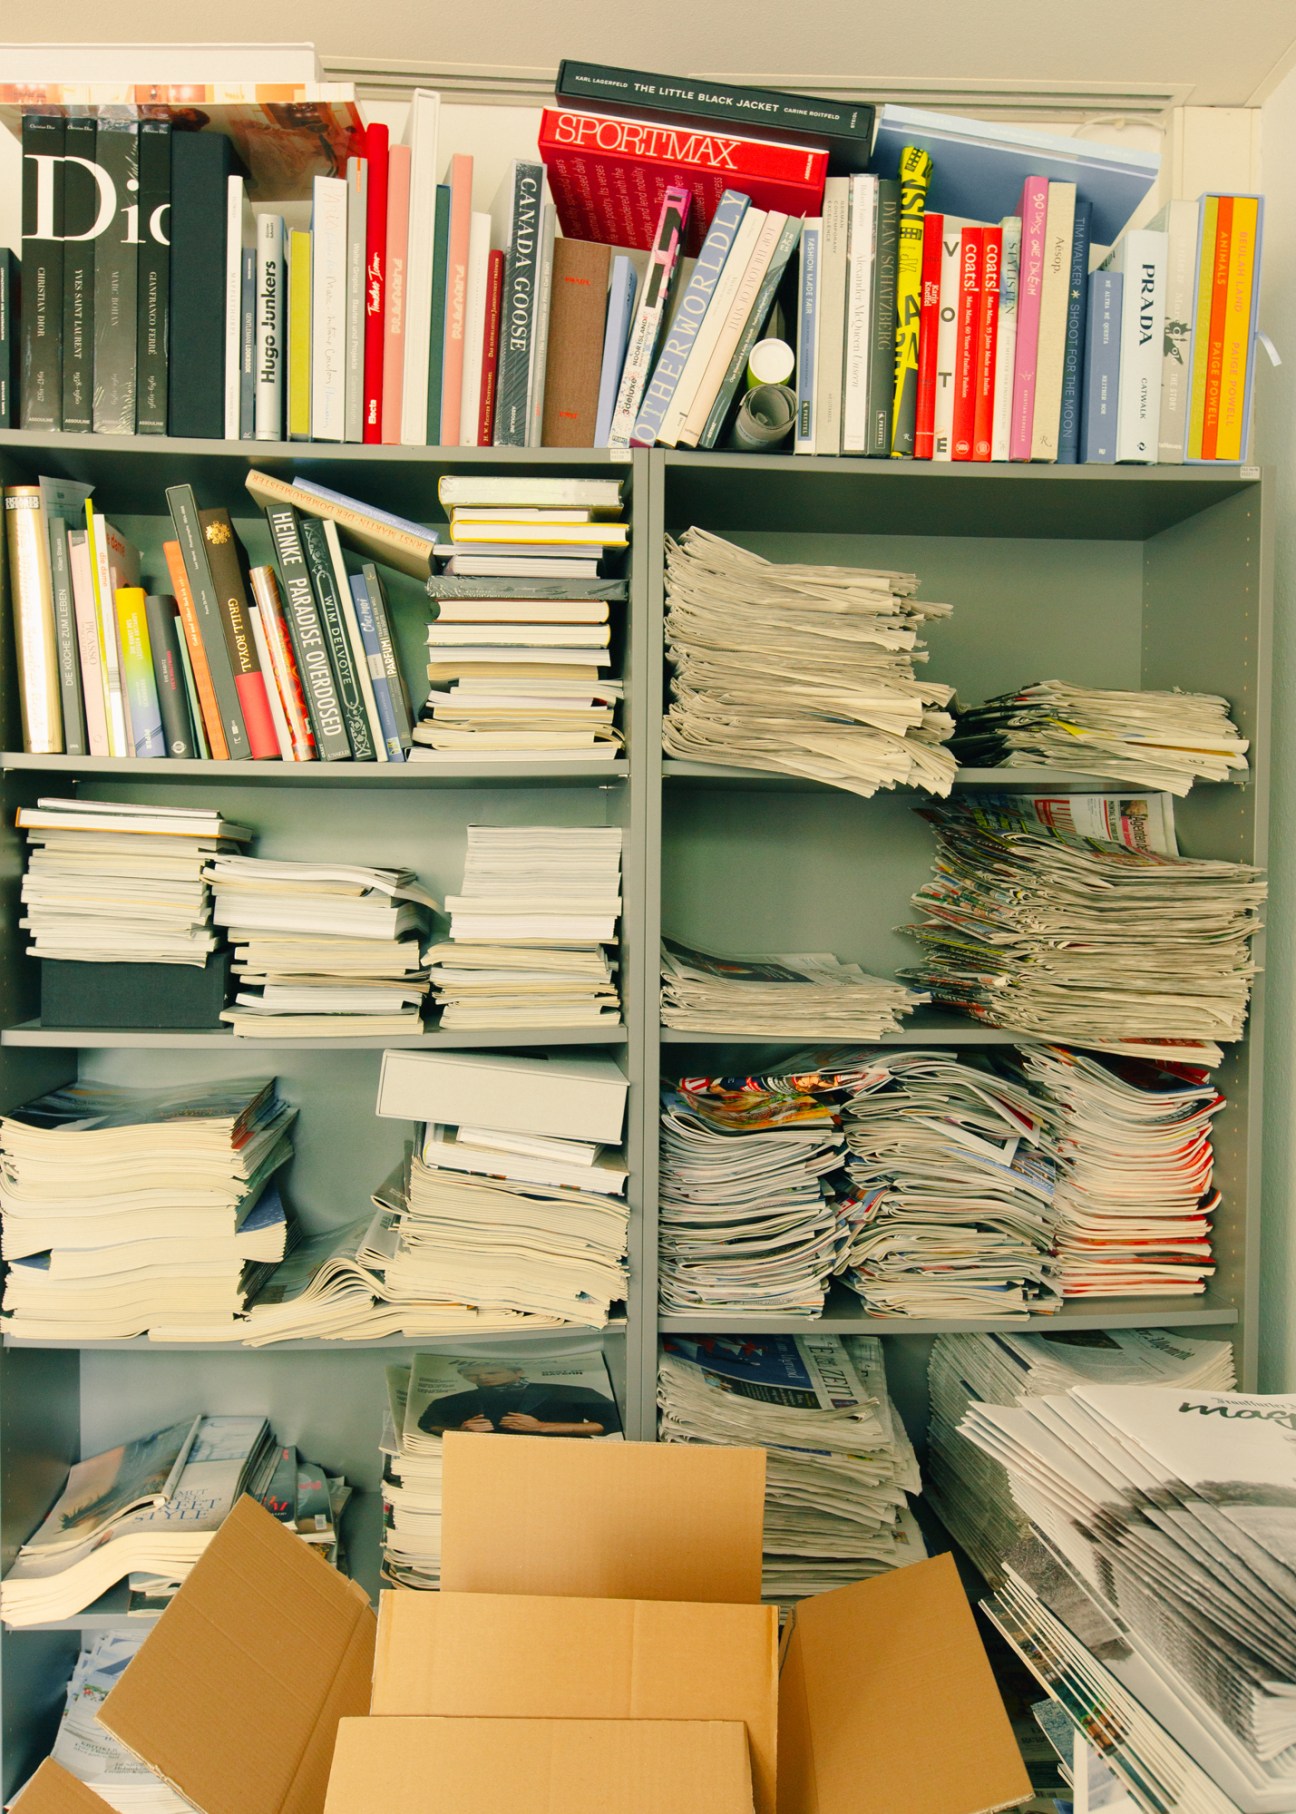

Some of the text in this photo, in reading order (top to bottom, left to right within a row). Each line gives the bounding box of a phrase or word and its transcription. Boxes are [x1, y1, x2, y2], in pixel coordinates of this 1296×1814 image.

[575, 75, 629, 89] KARL LAGERFELD
[634, 83, 781, 113] THE LITTLE BLACK JACKET
[784, 107, 840, 121] CARINE ROITFELD
[555, 113, 742, 169] SPORTMAX
[555, 159, 569, 177] years
[573, 157, 587, 174] daily
[594, 165, 606, 186] verses
[613, 168, 625, 179] the
[578, 175, 591, 198] infused
[583, 199, 593, 211] has
[616, 179, 627, 194] with
[632, 167, 651, 220] and lend nobility
[654, 176, 667, 204] They are
[693, 182, 708, 220] clothes that
[713, 176, 723, 198] excess
[1031, 193, 1046, 209] 90
[606, 219, 616, 233] with
[617, 195, 636, 236] embroidered
[1030, 211, 1044, 235] DAYS
[508, 178, 537, 351] CANADA GOOSE
[805, 237, 815, 273] FASHION
[1030, 239, 1041, 257] ONE
[1051, 236, 1066, 274] Aesop.
[1216, 230, 1229, 286] ANIMALS
[111, 271, 120, 295] MARC
[804, 273, 815, 297] MADE
[963, 243, 980, 293] coats!
[985, 243, 1000, 293] coats!
[1004, 242, 1018, 315] STYLISTEN
[1233, 230, 1249, 313] BEULAH LAND
[37, 267, 46, 338] CHRISTIAN DIOR
[148, 271, 158, 356] GIANFRANCO FERRÉ
[804, 298, 814, 314] FAIR
[930, 284, 939, 304] Karin
[1139, 263, 1156, 346] PRADA
[73, 269, 84, 360] YVES SAINT LAURENT
[245, 312, 253, 344] GENTLEMAN
[260, 260, 279, 385] Hugo Junkers
[624, 188, 755, 445] OTHERWORLDLY
[851, 253, 867, 388] Alexander McQueen Unseen
[1062, 217, 1086, 439] TIM WALKER SHOOT FOR THE MOON
[619, 375, 639, 415] 3deluxe
[1100, 374, 1108, 401] NEITHER
[1140, 377, 1149, 420] CATWALK
[1168, 371, 1179, 412] THE STORY
[1207, 340, 1222, 426] PAIGE POWELL
[1225, 341, 1242, 426] PAIGE POWELL
[368, 399, 379, 425] Electa
[249, 469, 429, 552] ERNST MARTIN DER DOMBAUMEISTER
[270, 509, 303, 567] HEINKE
[287, 576, 322, 649] PARADISE
[57, 587, 74, 686] DIE KÜCHE ZUM LEBEN
[85, 618, 98, 665] PICASSO
[225, 596, 253, 673] GRILL ROYAL
[323, 594, 352, 686] WIM DELVOYE
[380, 638, 397, 675] PARFUM
[304, 648, 344, 737] OVERDOSED
[1129, 815, 1149, 842] Agenten
[818, 1368, 855, 1397] ZEIT
[134, 1509, 210, 1521] STYLE
